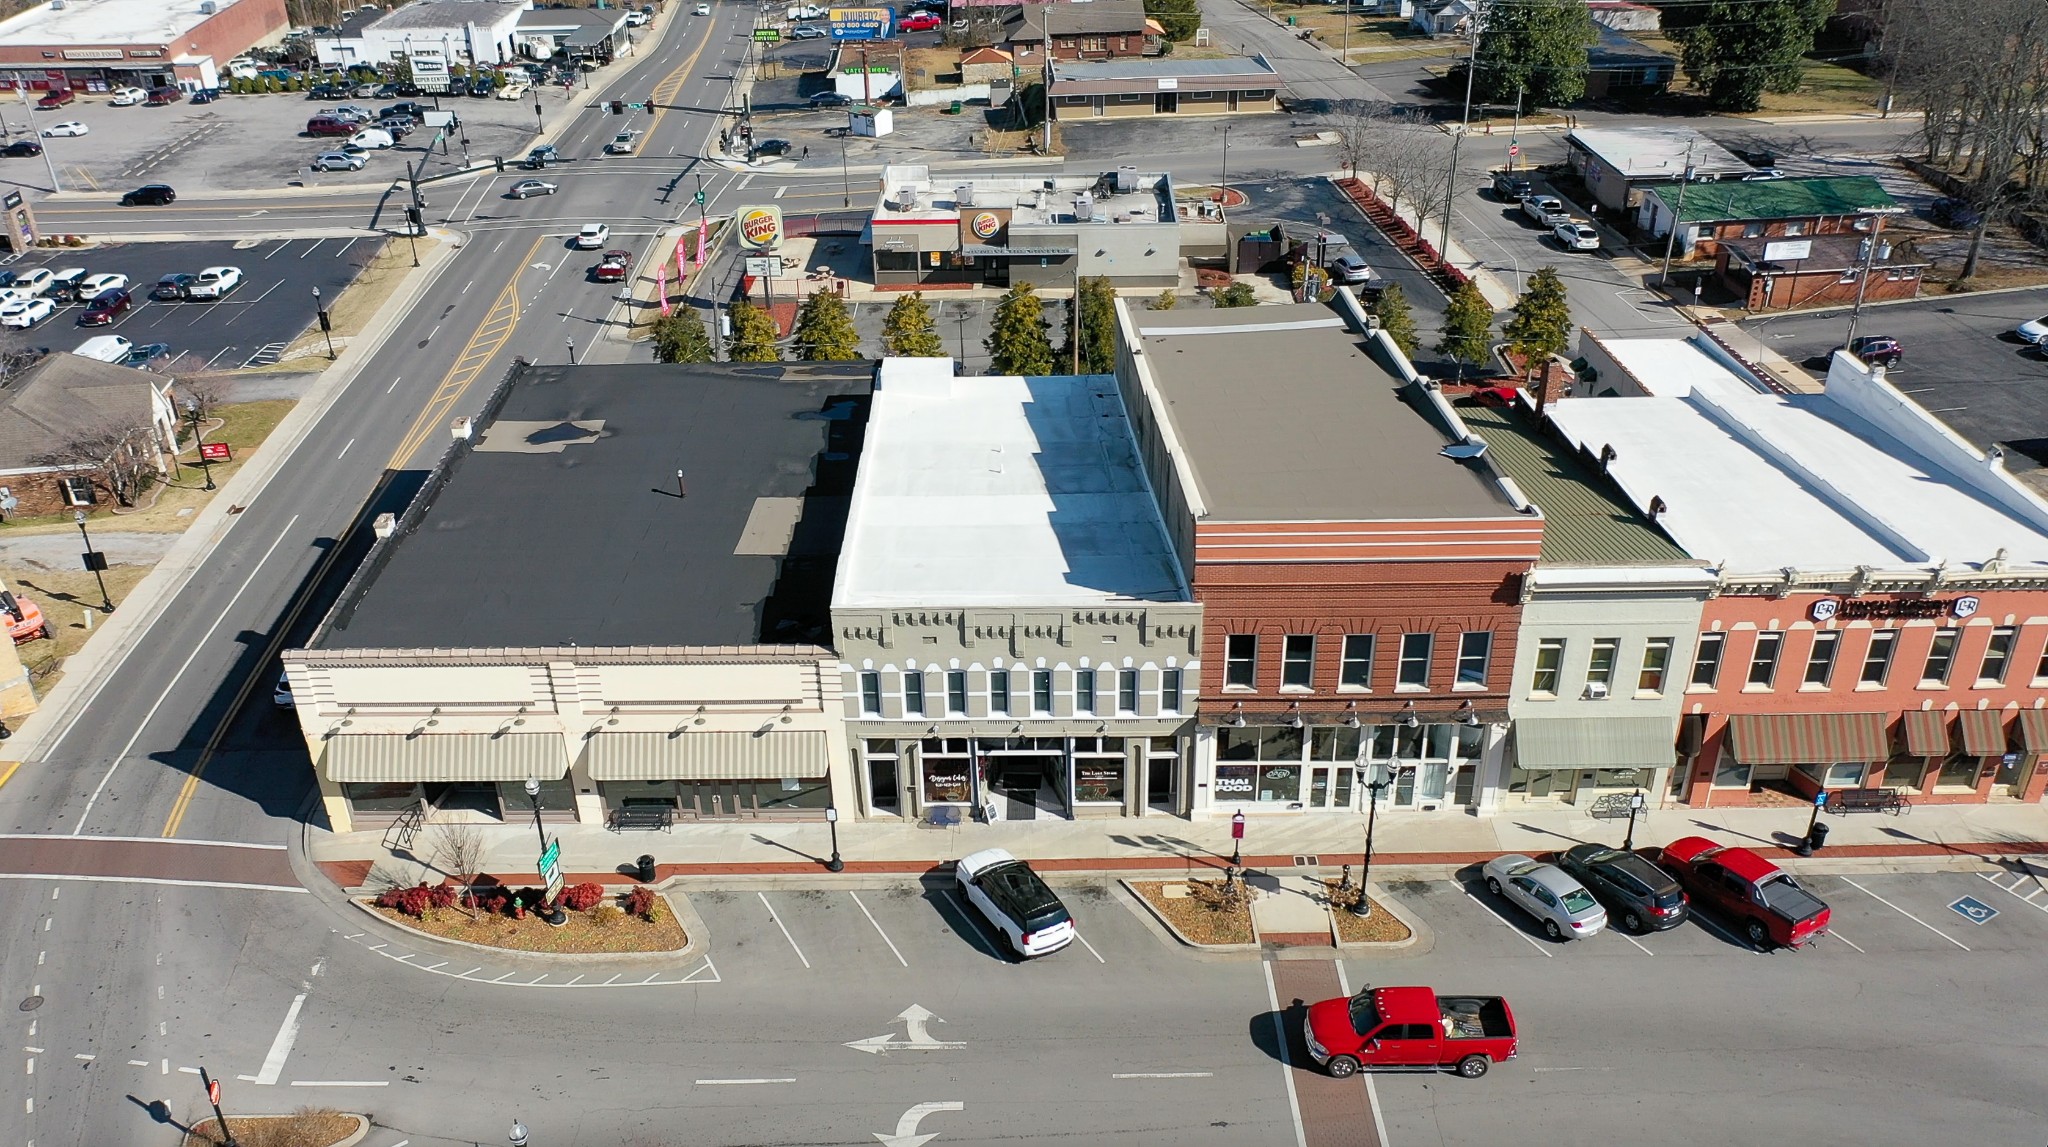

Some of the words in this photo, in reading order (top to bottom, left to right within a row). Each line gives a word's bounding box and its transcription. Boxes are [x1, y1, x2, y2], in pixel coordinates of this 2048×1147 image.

[743, 215, 774, 230] BURGER
[977, 217, 995, 226] BURGER
[978, 221, 996, 231] KING
[745, 222, 777, 239] KING
